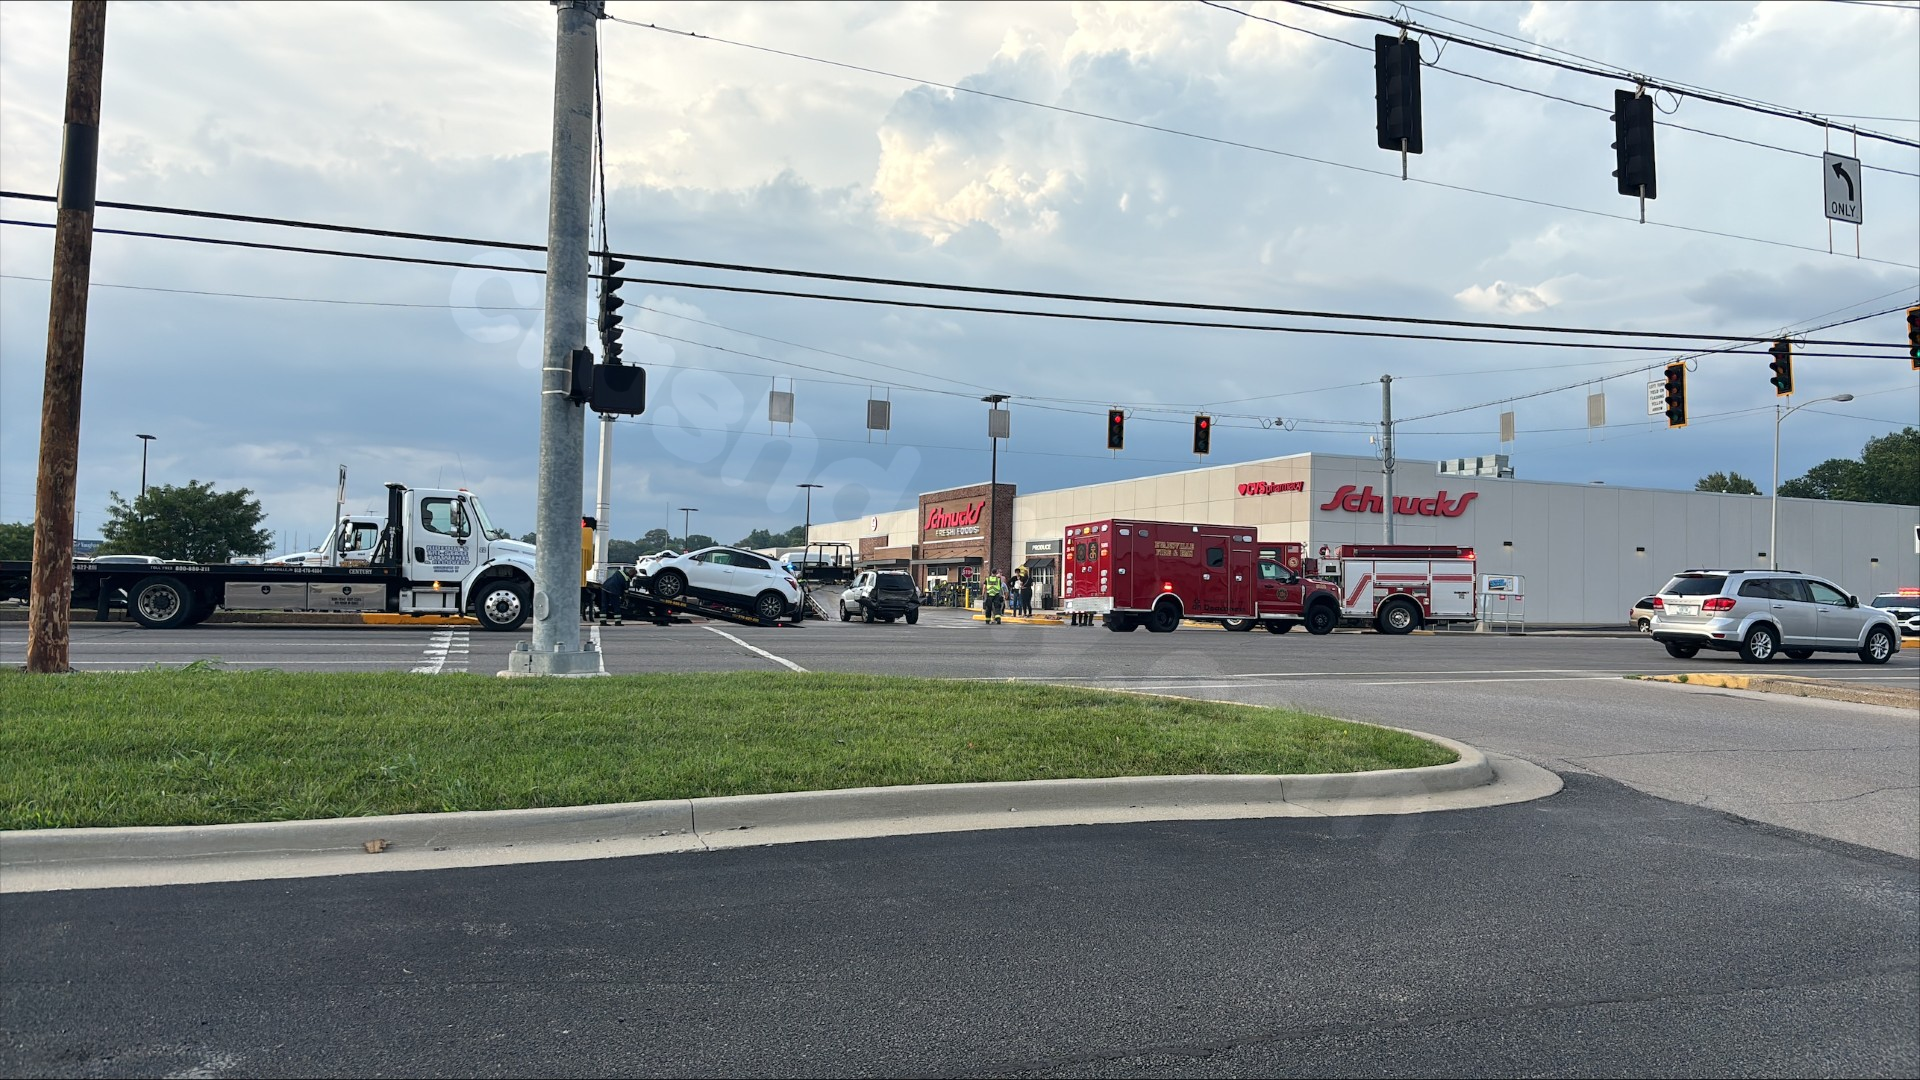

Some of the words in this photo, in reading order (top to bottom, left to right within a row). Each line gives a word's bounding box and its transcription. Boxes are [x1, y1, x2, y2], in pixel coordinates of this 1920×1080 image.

[1831, 201, 1856, 217] ONLY
[1247, 481, 1267, 495] CVS
[1266, 481, 1304, 496] pharmacy
[925, 501, 986, 530] Schnucks
[956, 525, 978, 535] FOODS
[1031, 543, 1052, 551] PRODUCE
